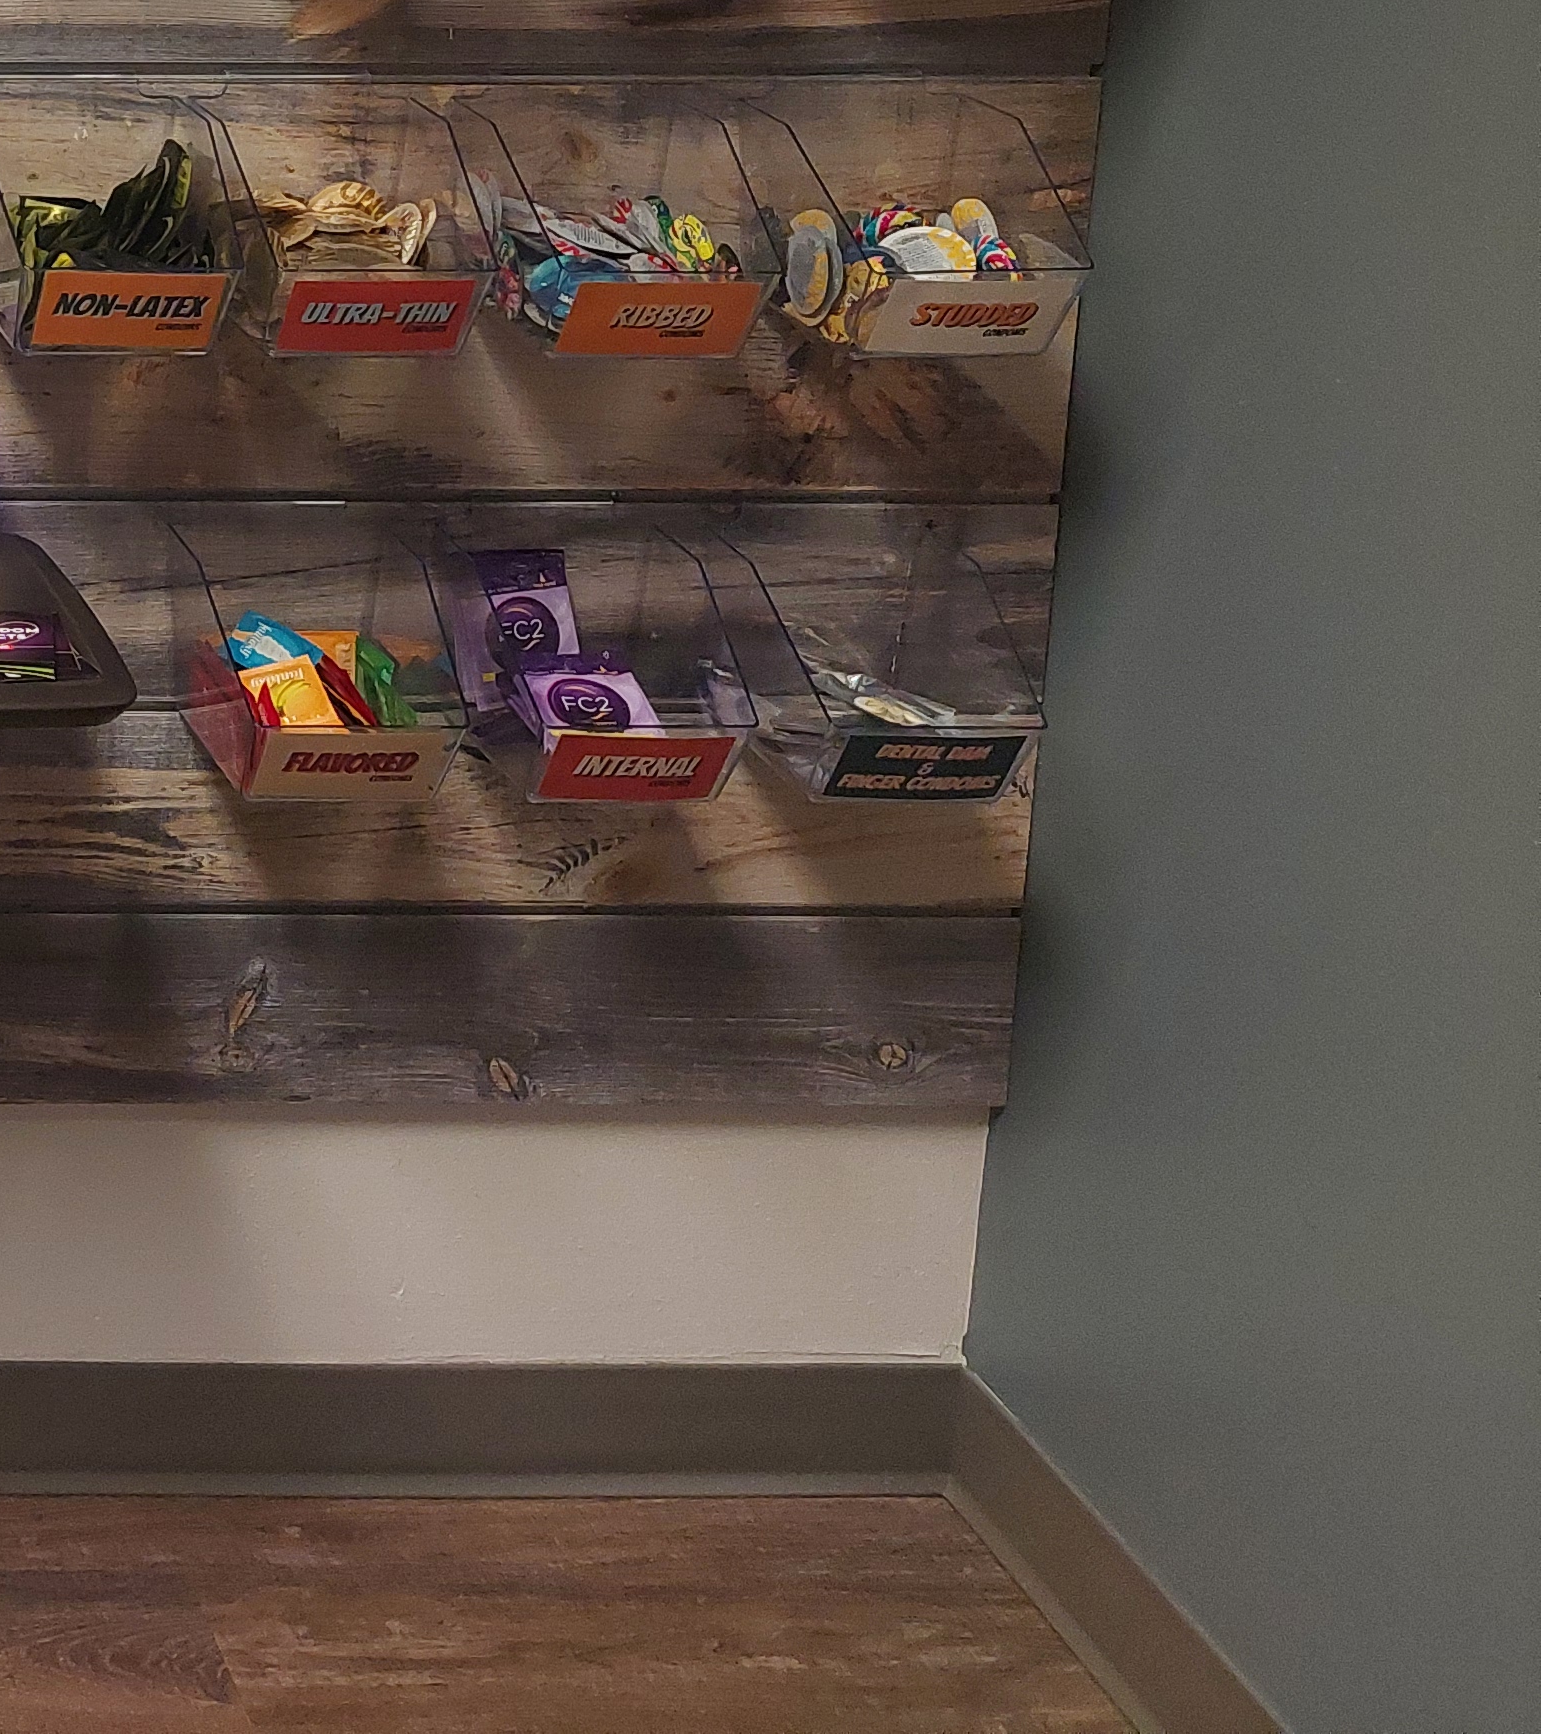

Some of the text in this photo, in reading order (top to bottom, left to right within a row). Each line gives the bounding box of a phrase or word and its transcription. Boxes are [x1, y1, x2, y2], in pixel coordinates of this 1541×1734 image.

[52, 293, 212, 319] NON-LATEX
[301, 301, 457, 324] ULTRA-THIN
[610, 304, 714, 329] RIBBED
[909, 302, 1039, 328] STUDDED
[282, 752, 419, 773] FLAVORED
[875, 744, 993, 760] DENTAL DAM
[572, 755, 703, 777] INTERNAL
[837, 774, 1001, 791] FINGER CONDOMS
